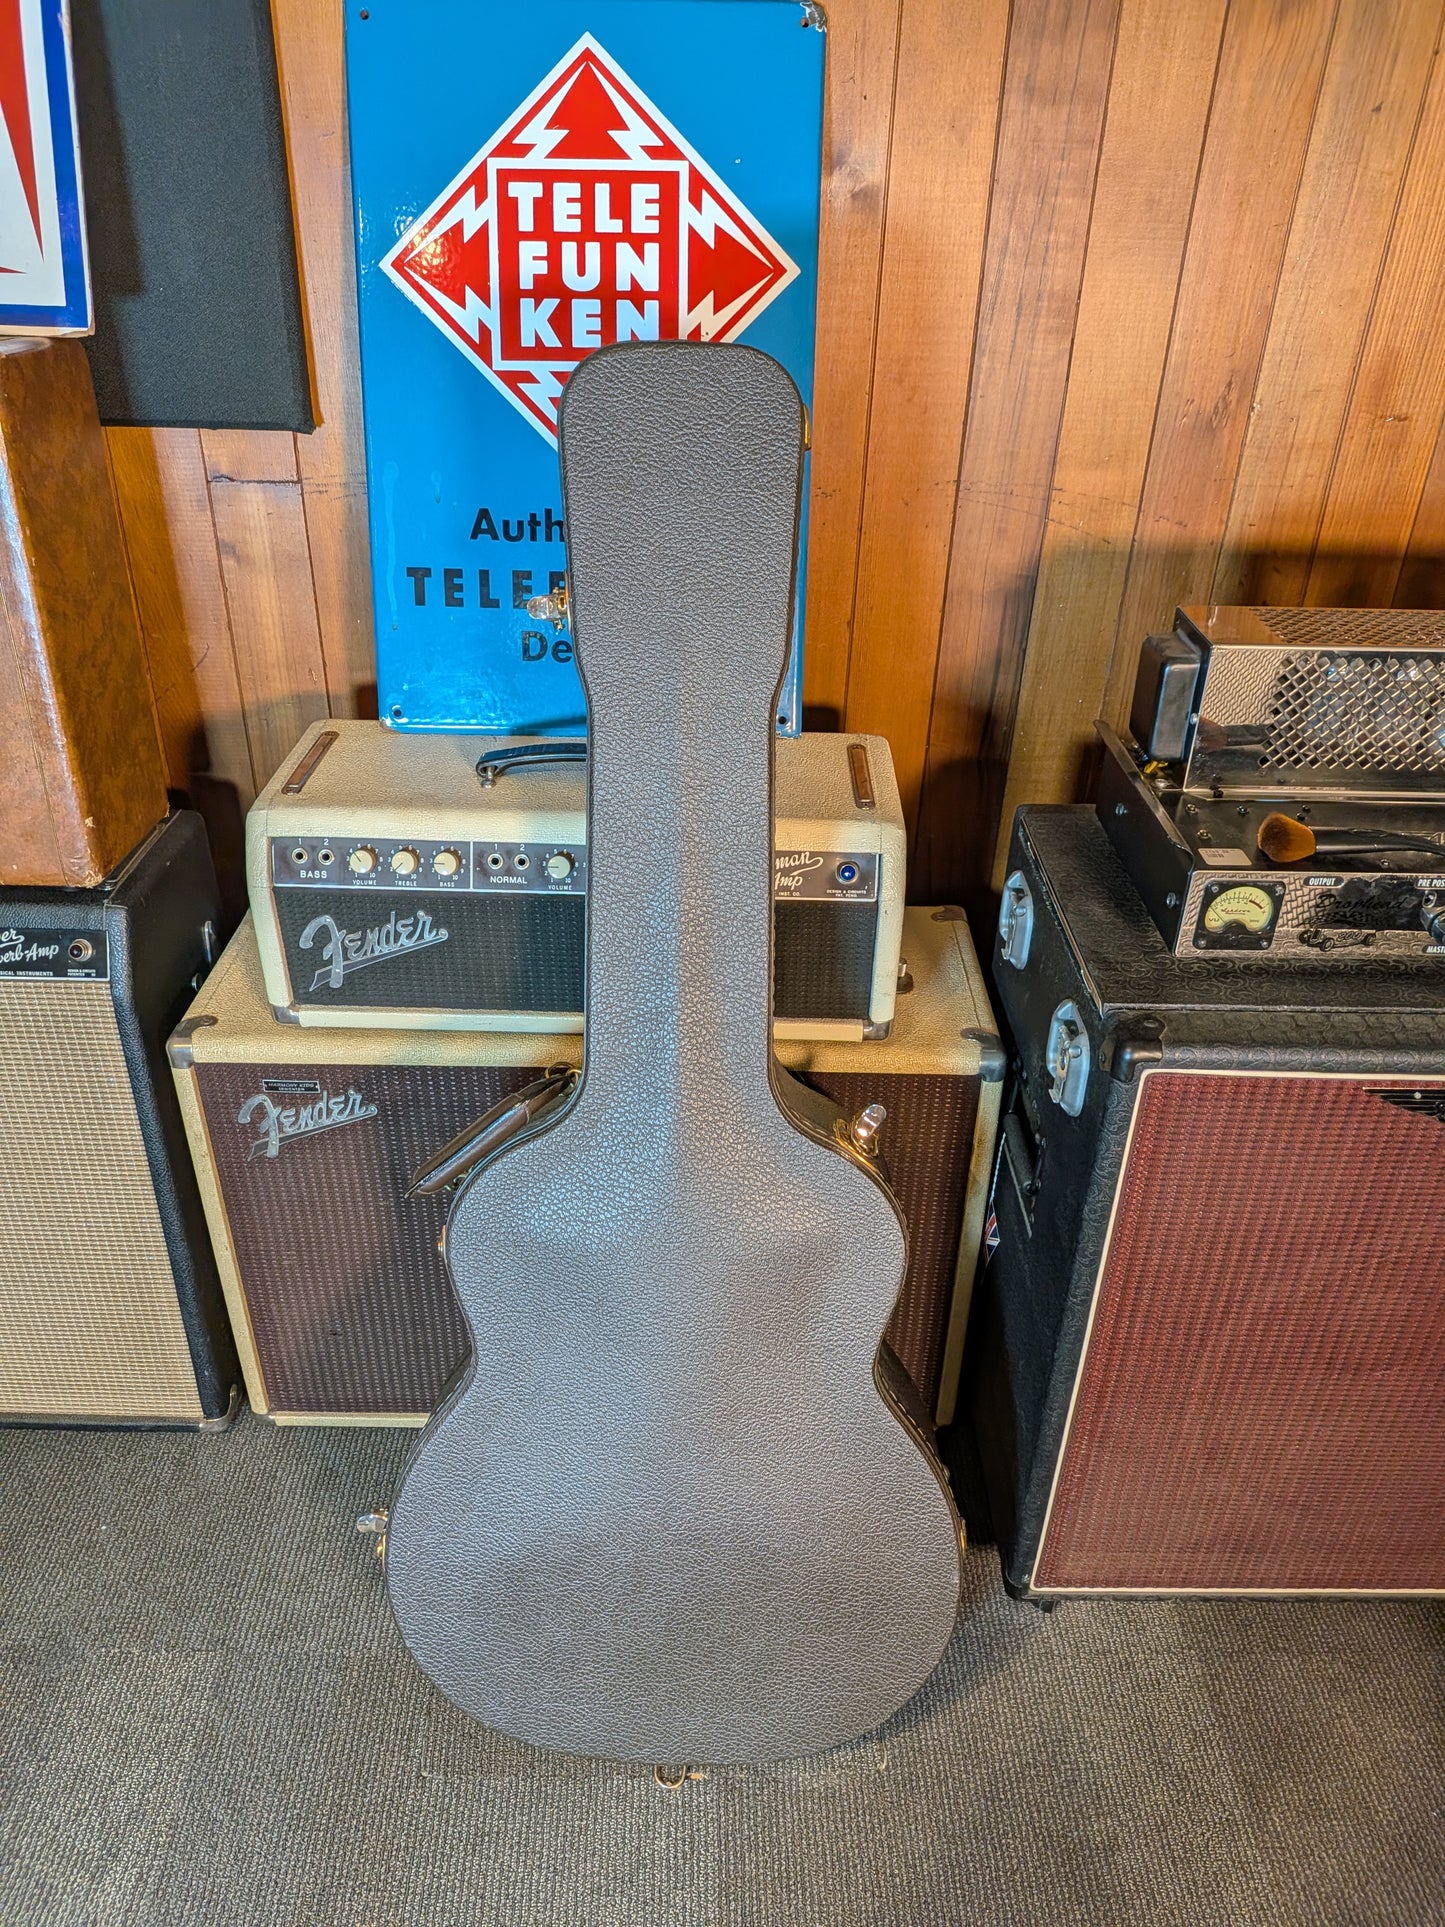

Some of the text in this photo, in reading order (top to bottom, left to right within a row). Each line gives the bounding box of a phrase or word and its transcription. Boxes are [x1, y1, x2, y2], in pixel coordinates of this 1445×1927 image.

[508, 182, 660, 233] TELE
[519, 240, 660, 292] FUN
[520, 298, 660, 348] KEN
[470, 508, 565, 543] Auth
[521, 631, 573, 663] De
[300, 870, 327, 878] BASS
[490, 876, 528, 884] NORMAL
[1308, 877, 1336, 886] OUTPUT
[1418, 879, 1431, 887] PRE
[1316, 893, 1409, 912] Drophead
[299, 910, 448, 990] Fender
[1337, 931, 1362, 942] 200
[238, 1090, 378, 1160] Fender
